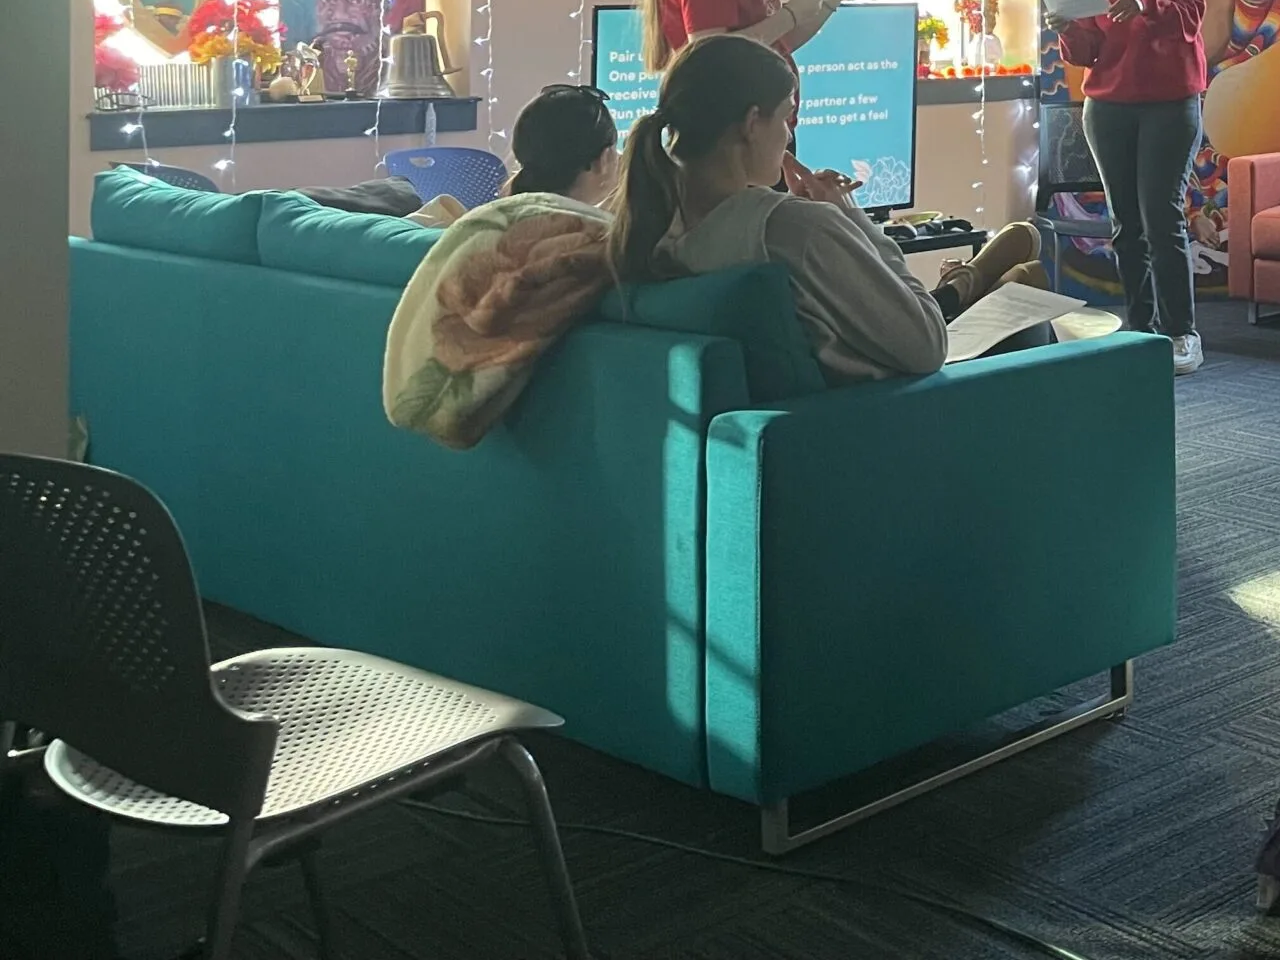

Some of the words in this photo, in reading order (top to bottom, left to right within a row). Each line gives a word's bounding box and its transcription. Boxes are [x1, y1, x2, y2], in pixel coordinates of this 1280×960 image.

[609, 50, 635, 63] Pair
[608, 70, 636, 82] One
[807, 63, 845, 75] person
[847, 61, 865, 71] act
[867, 61, 879, 70] as
[880, 58, 898, 69] the
[806, 96, 847, 110] partner
[849, 97, 856, 105] a
[858, 93, 878, 104] few
[826, 114, 837, 123] to
[840, 113, 857, 126] get
[859, 113, 866, 121] a
[868, 109, 889, 120] feel
